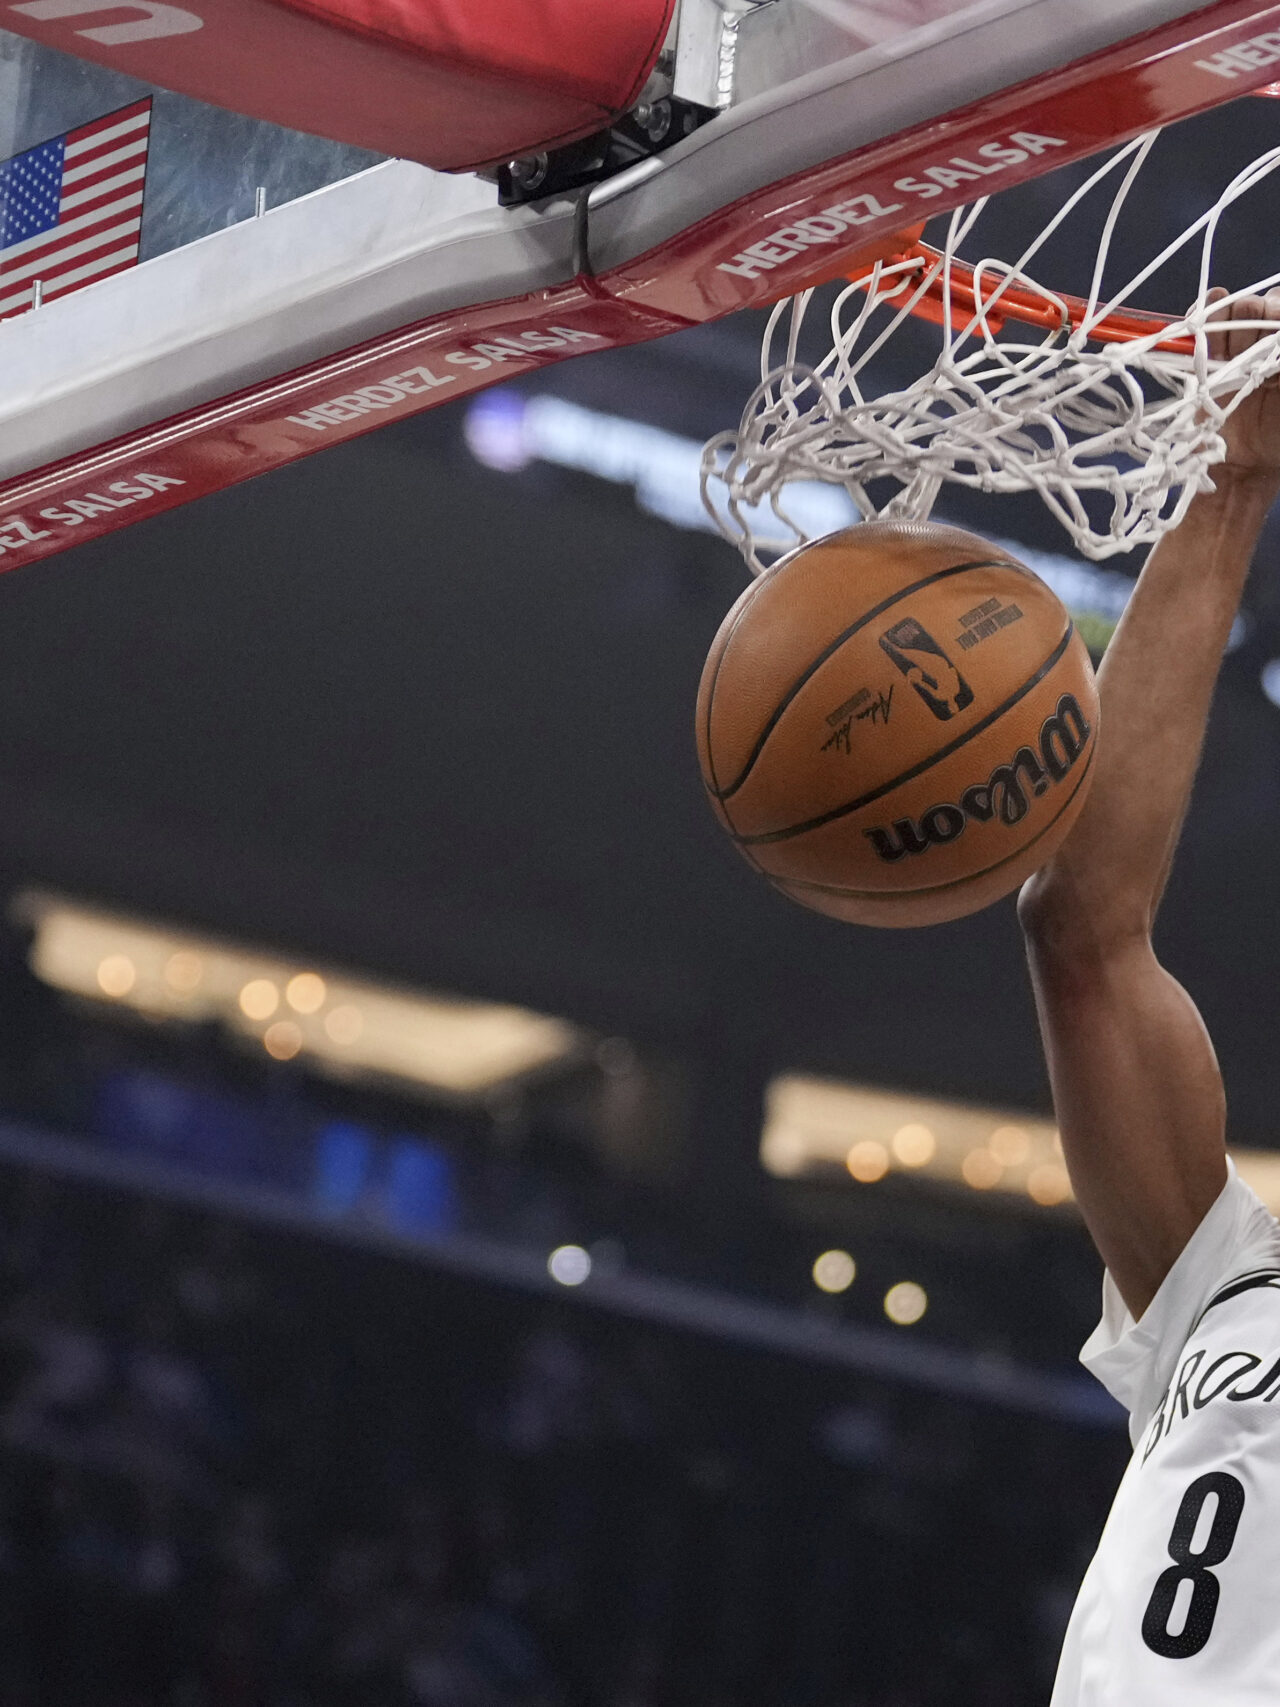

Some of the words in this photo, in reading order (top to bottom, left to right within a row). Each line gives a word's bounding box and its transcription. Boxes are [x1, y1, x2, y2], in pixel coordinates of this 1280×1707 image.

[716, 194, 903, 279] HERDEZ
[894, 131, 1068, 198] SALSA
[284, 366, 456, 430] HERDEZ
[445, 326, 600, 370] SALSA
[40, 473, 187, 525] SALSA
[863, 693, 1091, 863] Wilson
[1141, 1471, 1245, 1659] 8
